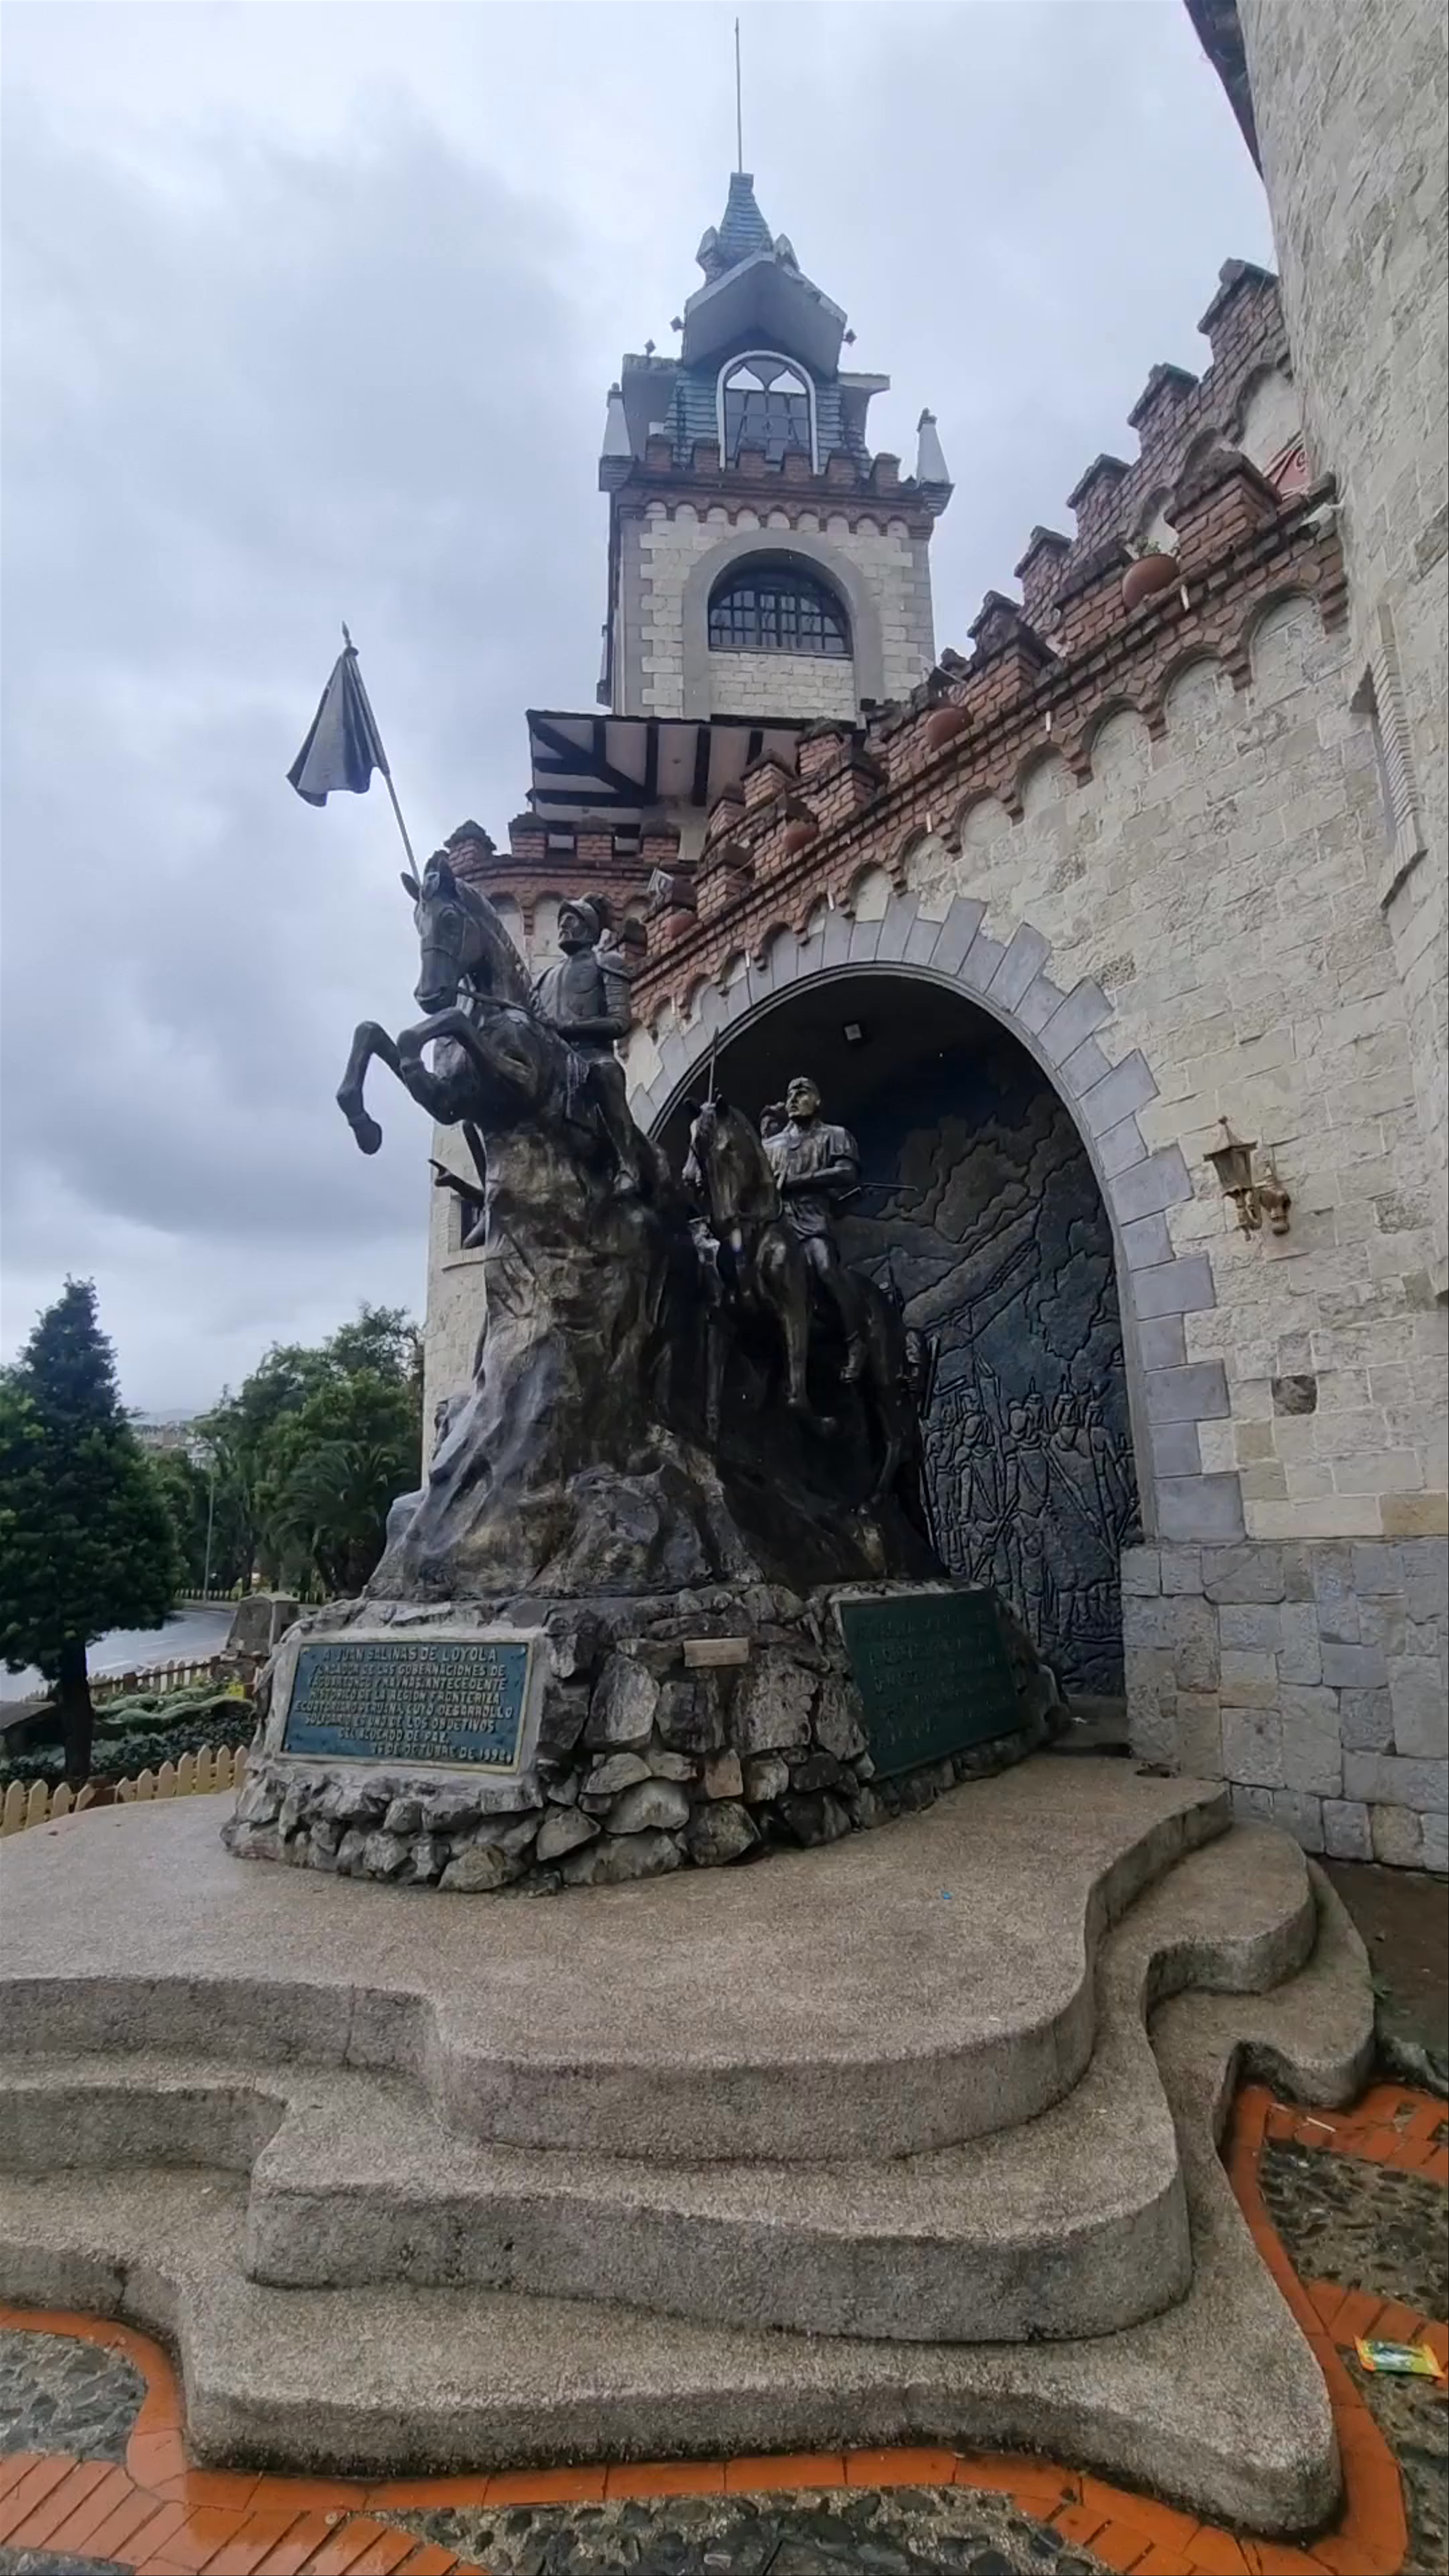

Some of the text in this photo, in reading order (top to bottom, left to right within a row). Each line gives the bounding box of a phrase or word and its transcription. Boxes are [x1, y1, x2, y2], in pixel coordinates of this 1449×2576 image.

[337, 1647, 365, 1661] JUAN
[367, 1647, 417, 1661] SALINAS
[420, 1646, 437, 1661] DE
[442, 1647, 496, 1661] LOYOLA
[361, 1664, 374, 1675] DE
[377, 1664, 396, 1675] LAS
[398, 1664, 486, 1676] GOBERNACIONES
[490, 1664, 506, 1676] DE
[426, 1677, 507, 1691] ANTECEDENTE
[358, 1689, 373, 1700] DE
[389, 1690, 426, 1701] REGION
[429, 1691, 499, 1704] FRONTERIZA
[406, 1703, 434, 1716] CUYO
[438, 1705, 512, 1718] DESARROLLO
[368, 1715, 388, 1727] UNO
[388, 1716, 403, 1728] DE
[407, 1715, 428, 1729] LOS
[431, 1718, 494, 1733] OBJETIVOS
[406, 1730, 420, 1742] DE
[385, 1742, 399, 1755] DE
[404, 1743, 456, 1758] OCTUBRE
[459, 1746, 475, 1760] DE
